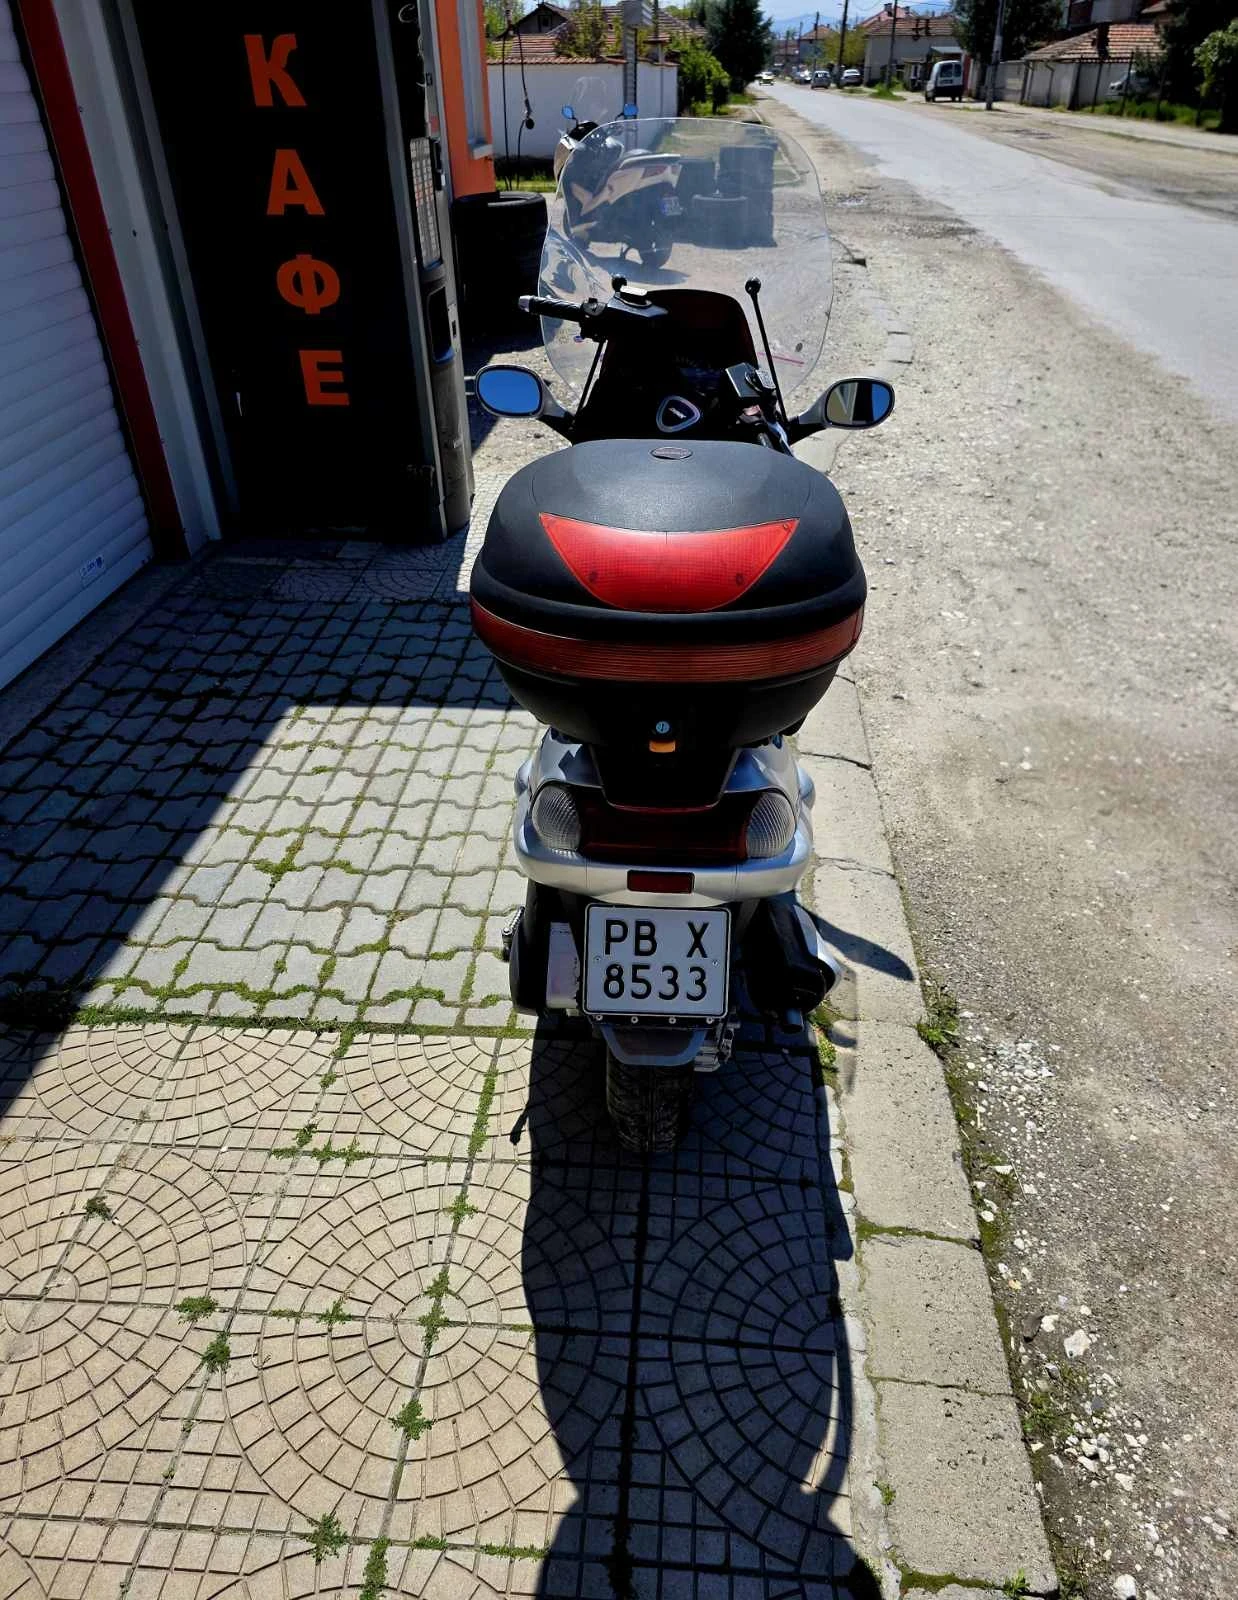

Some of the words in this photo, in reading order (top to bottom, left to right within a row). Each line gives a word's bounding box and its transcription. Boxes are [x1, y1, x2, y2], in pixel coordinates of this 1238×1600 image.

[244, 34, 350, 406] КАФЕ
[604, 919, 658, 957] PB
[686, 921, 710, 958] X
[603, 963, 708, 1001] 8533
